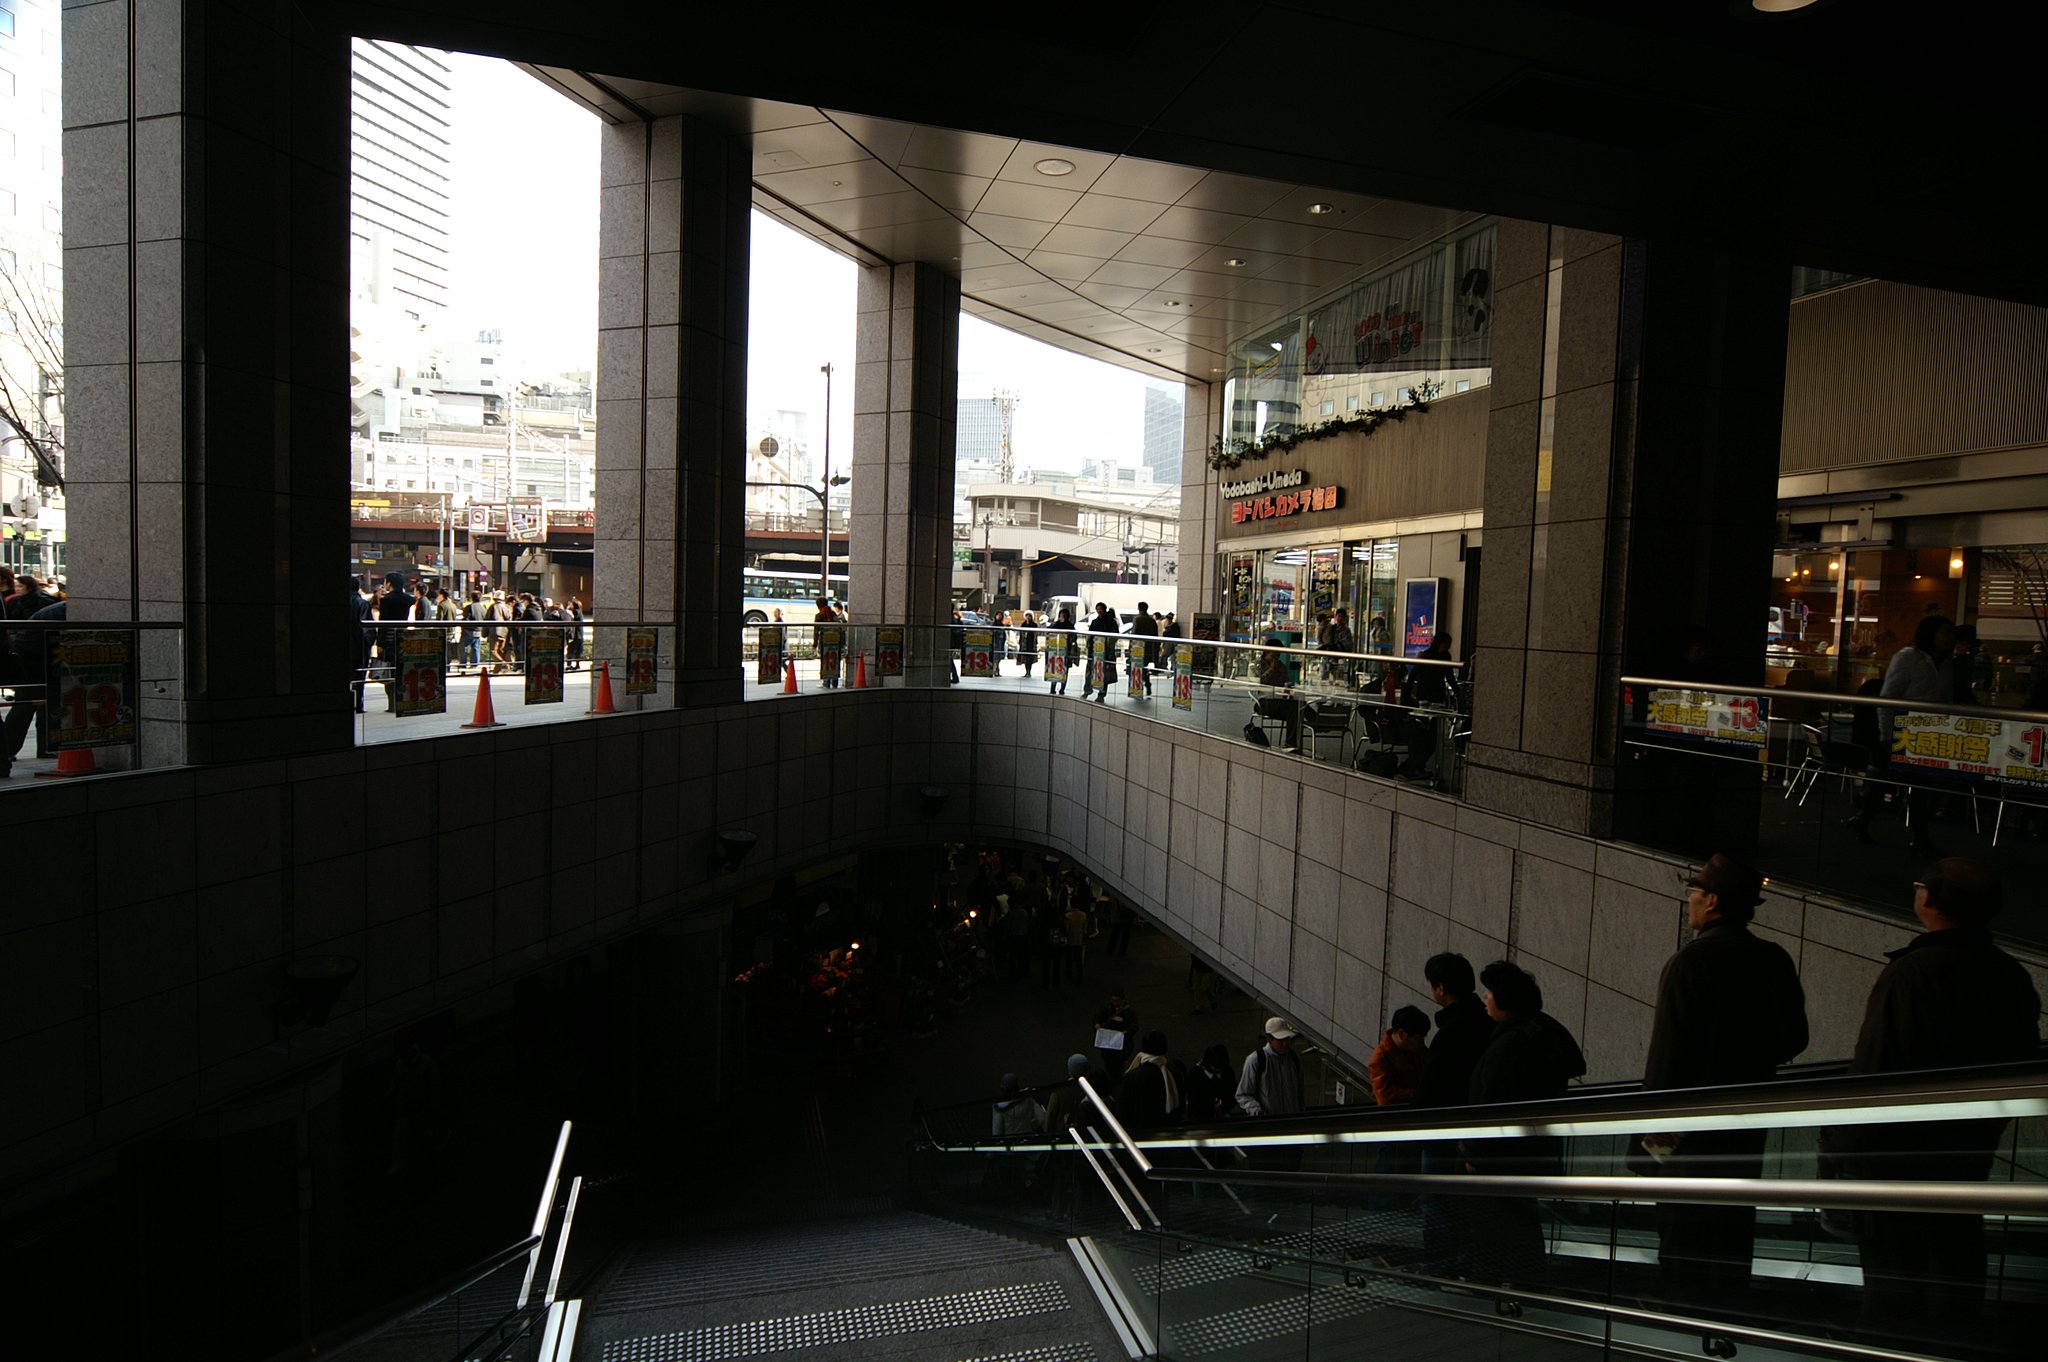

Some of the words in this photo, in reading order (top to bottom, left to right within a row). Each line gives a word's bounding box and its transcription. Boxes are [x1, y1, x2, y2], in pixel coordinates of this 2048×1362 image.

[1220, 468, 1302, 499] Yodobashi-Umeda
[1232, 485, 1337, 523] ヨドバシカメラ梅田
[825, 650, 839, 670] 13
[880, 651, 899, 669] 13
[967, 652, 988, 670] 13
[1049, 656, 1064, 674] 13
[404, 668, 438, 700] 13
[532, 663, 558, 692] 13
[1132, 667, 1143, 690] 13
[1177, 674, 1191, 700] 13
[63, 683, 120, 729] 13
[1728, 697, 1760, 731] 13
[1954, 717, 2002, 737] 4周年
[1891, 728, 1990, 764] 大感謝祭
[2022, 726, 2048, 766] 1
